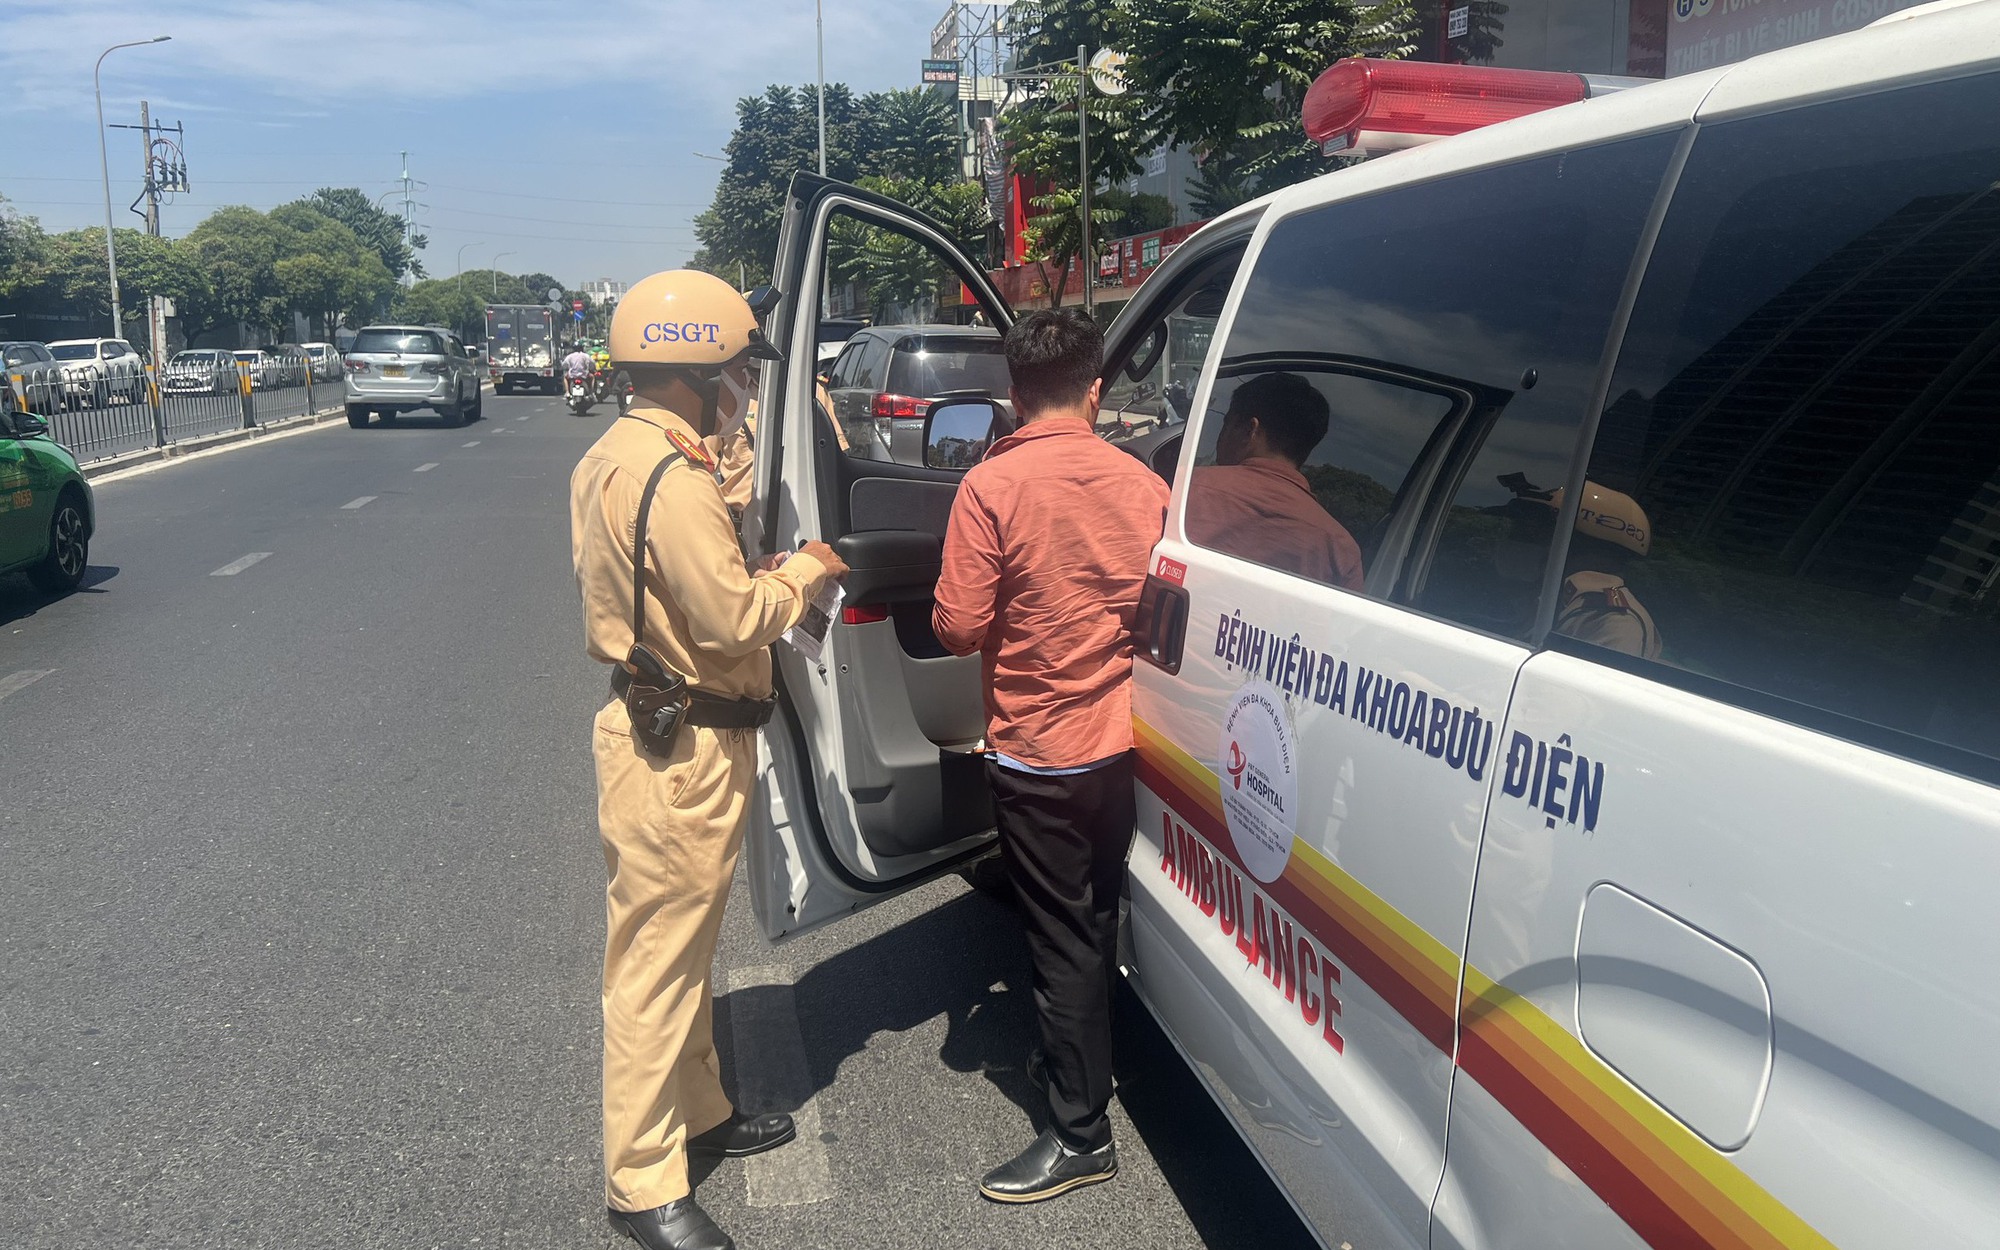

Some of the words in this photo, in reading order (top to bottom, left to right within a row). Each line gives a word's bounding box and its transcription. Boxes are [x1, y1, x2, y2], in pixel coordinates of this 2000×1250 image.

[1775, 6, 1821, 44] SINH
[643, 322, 720, 344] CSGT
[1166, 565, 1183, 579] CLOSED
[1214, 608, 1266, 674] BỆNH
[1265, 632, 1316, 701] VIỆN
[1314, 652, 1349, 716] ĐA
[1503, 732, 1605, 832] ĐIỆN
[1260, 696, 1275, 719] KHOA
[1246, 772, 1285, 814] HOSPITAL
[1160, 809, 1346, 1057] AMBULANCE
